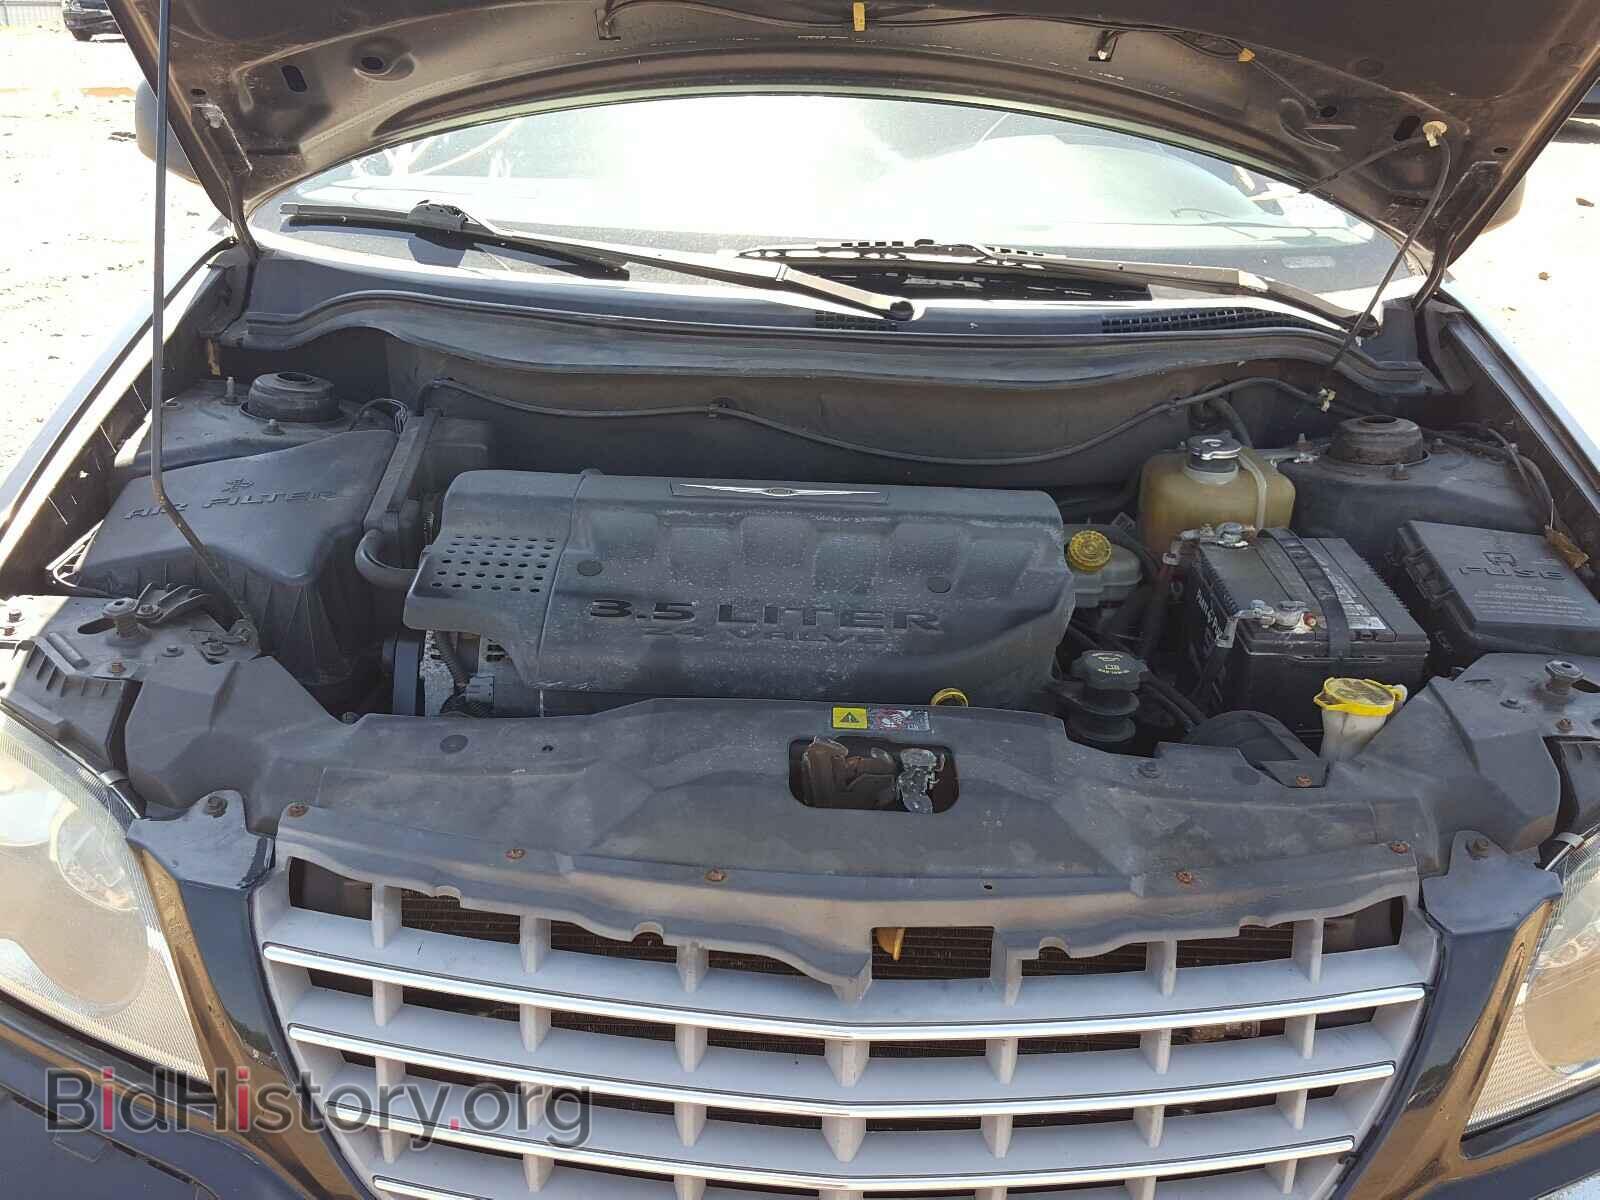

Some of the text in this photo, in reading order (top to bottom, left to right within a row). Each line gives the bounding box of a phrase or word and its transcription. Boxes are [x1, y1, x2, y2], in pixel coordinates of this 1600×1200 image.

[123, 490, 337, 520] AIR FILTER
[1458, 566, 1567, 581] FUSE
[589, 600, 944, 632] 3.5 LITER
[725, 629, 887, 645] VALVE
